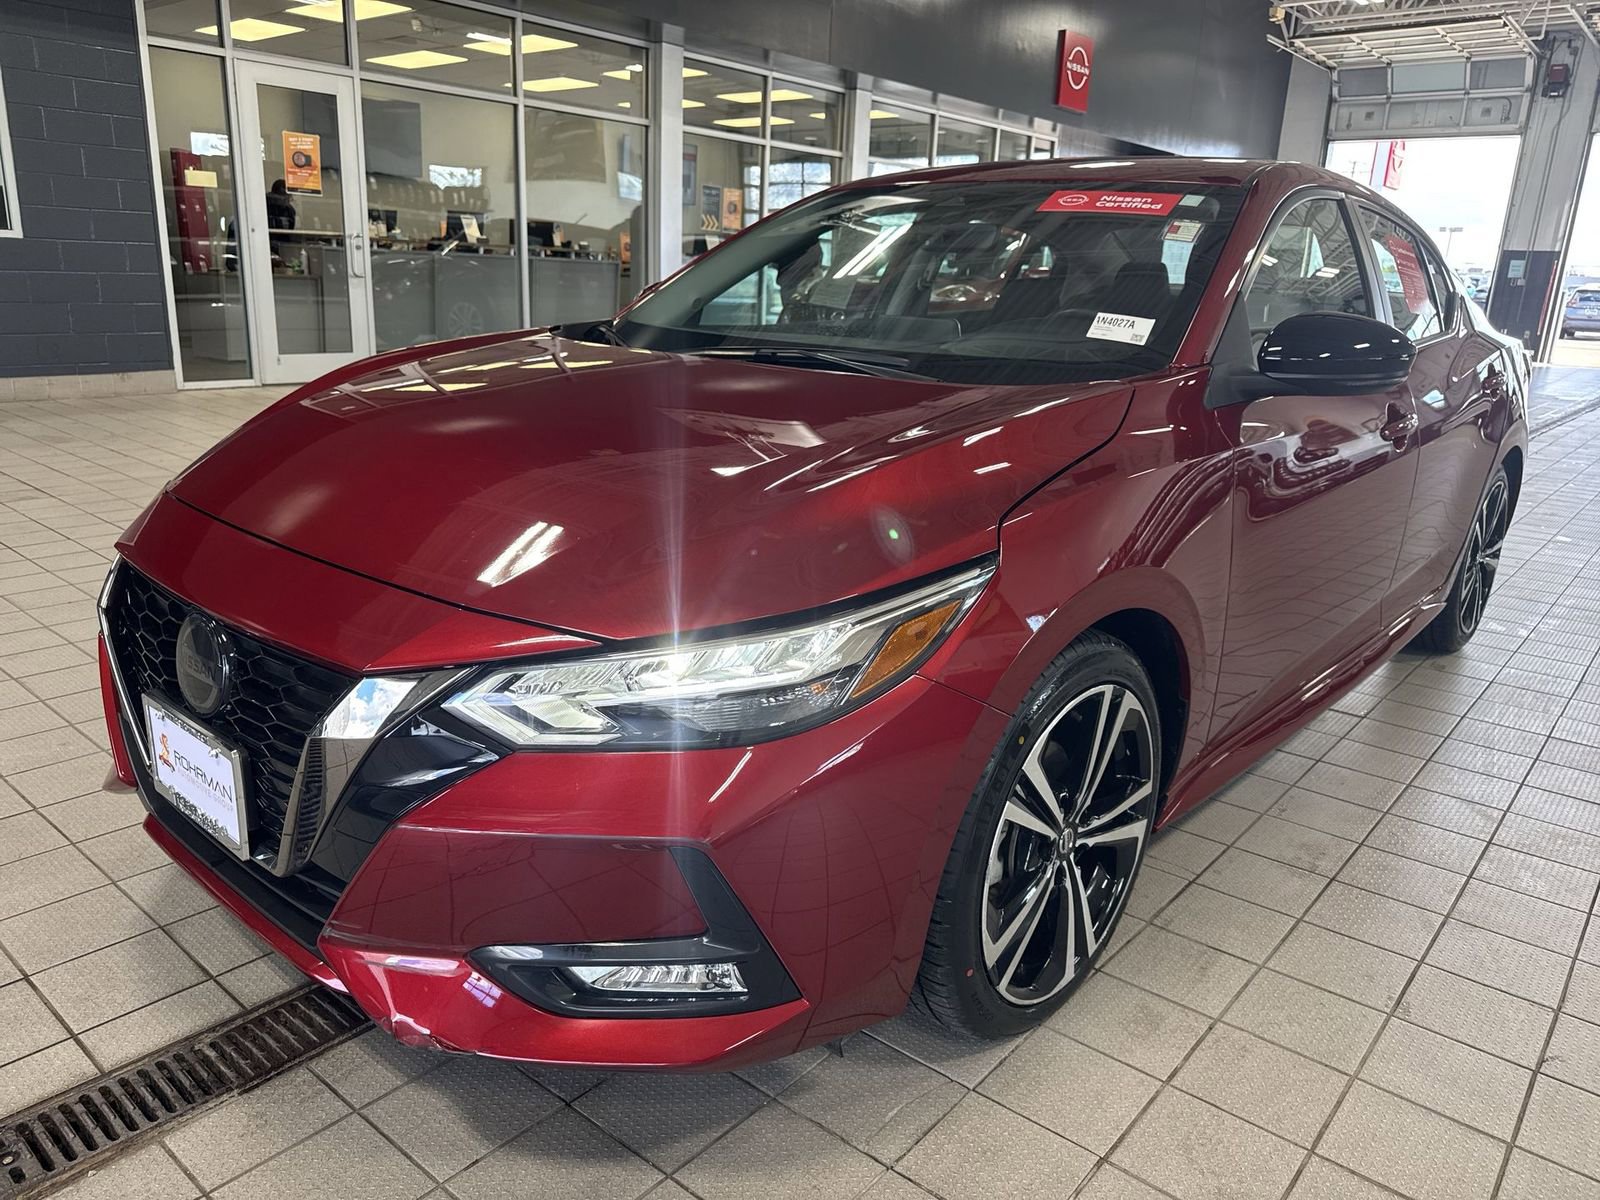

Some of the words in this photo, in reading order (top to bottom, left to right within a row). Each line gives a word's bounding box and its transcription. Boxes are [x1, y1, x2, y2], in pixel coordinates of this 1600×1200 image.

[1066, 61, 1090, 75] NISSAN
[1095, 201, 1163, 210] Certified
[1100, 195, 1153, 203] Nissan
[183, 650, 216, 681] ISSAN
[173, 749, 233, 803] ROHRMAN
